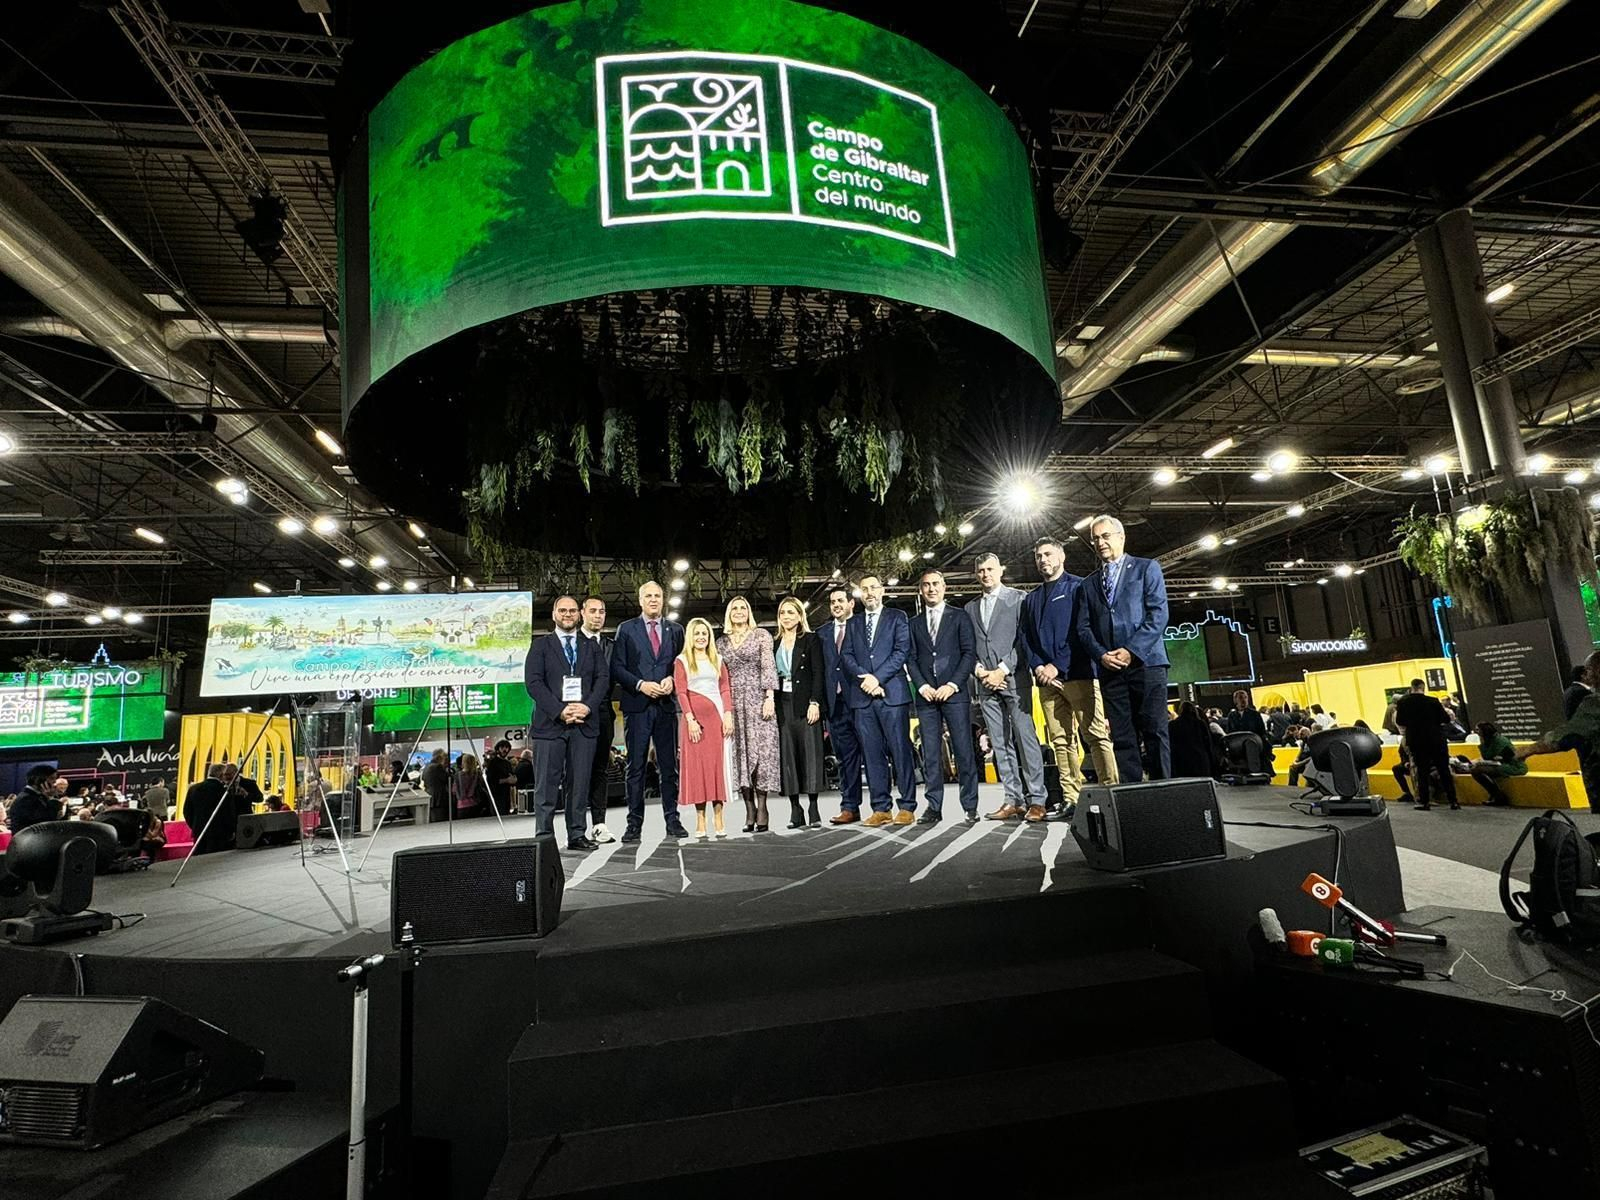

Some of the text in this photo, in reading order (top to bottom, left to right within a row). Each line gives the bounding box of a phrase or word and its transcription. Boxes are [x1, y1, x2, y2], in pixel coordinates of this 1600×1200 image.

[807, 121, 884, 152] Campo
[810, 142, 930, 187] de Gibraltar
[812, 163, 884, 193] Centro
[815, 186, 921, 224] del mundo
[1291, 640, 1366, 653] SHOWCOOKING
[250, 666, 290, 691] Vive
[294, 672, 325, 682] una
[400, 660, 418, 683] de
[420, 666, 488, 679] emociones
[293, 659, 351, 674] Campo
[359, 655, 378, 670] de
[52, 671, 141, 688] TURISMO
[505, 729, 526, 740] ca
[96, 744, 181, 767] Andalucía
